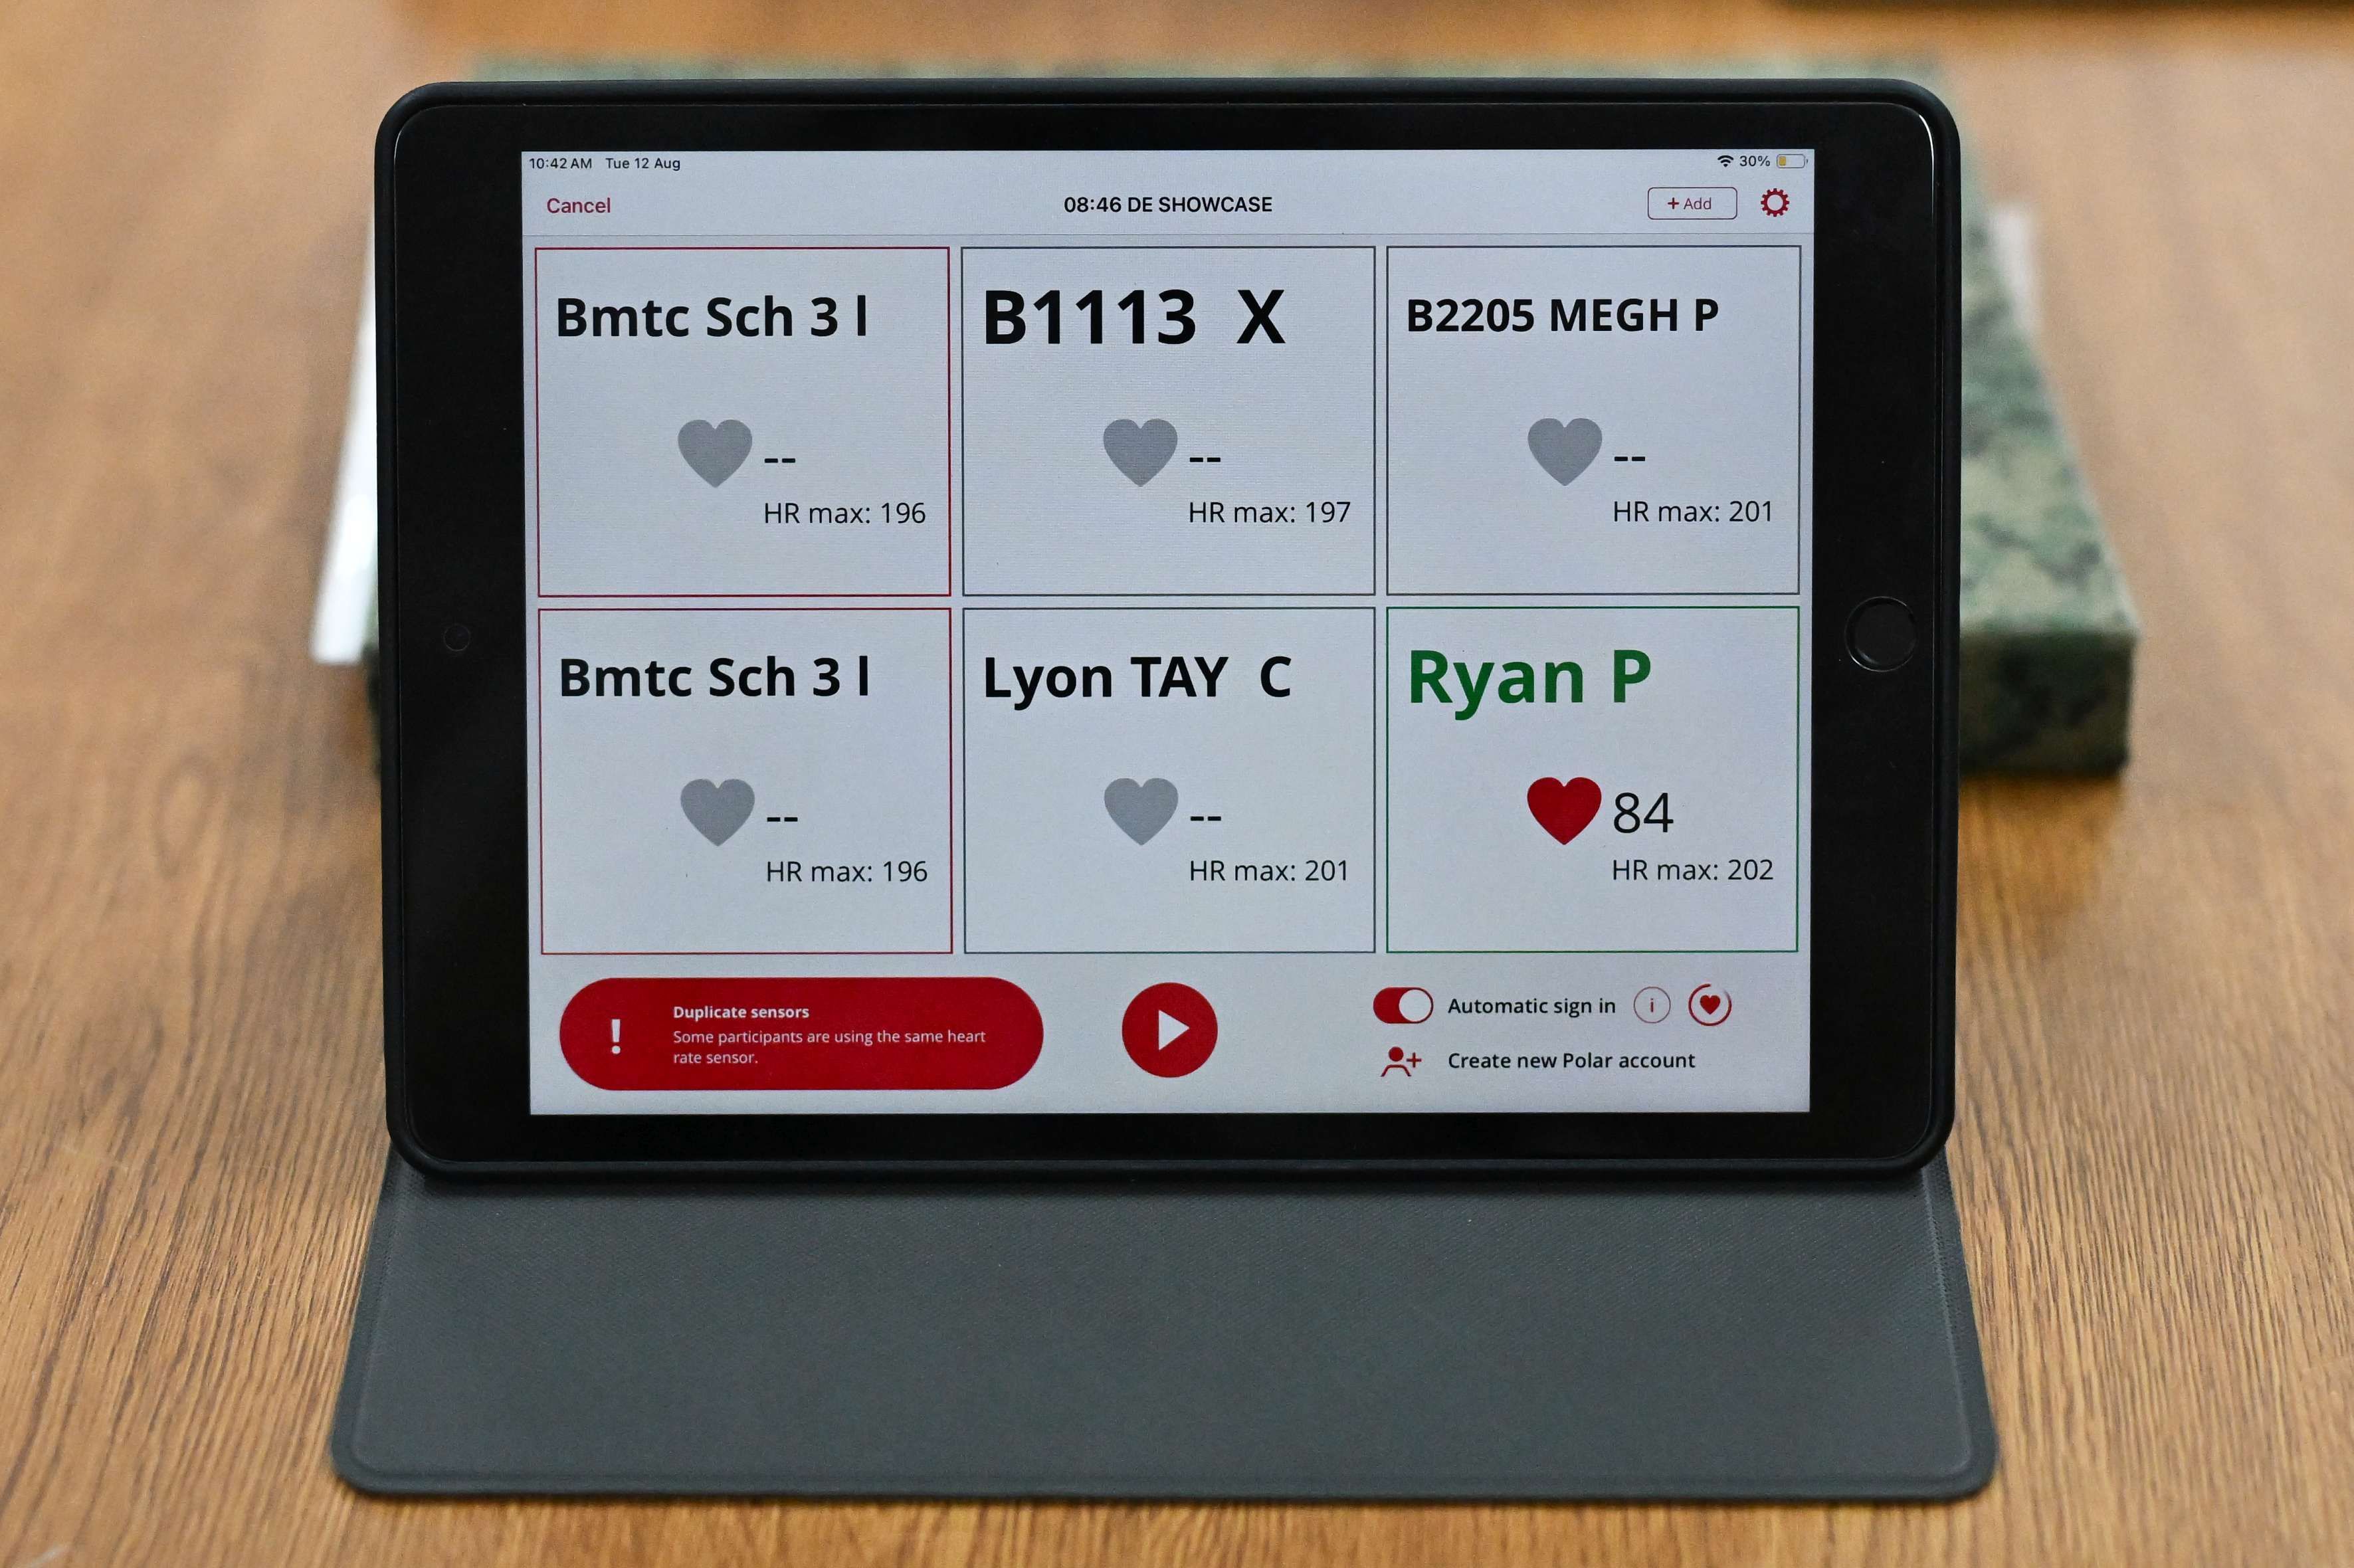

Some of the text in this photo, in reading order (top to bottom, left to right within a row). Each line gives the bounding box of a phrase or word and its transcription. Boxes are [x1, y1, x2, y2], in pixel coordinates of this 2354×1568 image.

[529, 157, 592, 169] 10:42 AM
[605, 157, 680, 172] Tue 12 Aug
[1739, 155, 1771, 167] 30%
[547, 197, 611, 214] Cancel
[1064, 196, 1272, 213] 08:46 DE SHOWCASE
[1683, 197, 1712, 211] Add
[557, 298, 690, 338] Bmtc
[706, 294, 793, 338] Sch
[811, 296, 838, 337] 3
[985, 289, 1286, 345] B1113 X
[1408, 298, 1719, 333] B2205 MEGH P
[765, 502, 926, 524] HR max: 196
[1189, 501, 1351, 524] HR max: 197
[1614, 500, 1771, 522] HR max: 201
[561, 658, 692, 698] Bmtc
[709, 655, 795, 697] Sch
[813, 657, 840, 697] 3
[985, 656, 1292, 711] Lyon TAY C
[1411, 649, 1651, 721] Ryan P
[1613, 792, 1674, 834] 84
[767, 860, 928, 882] HR max: 196
[1190, 860, 1346, 882] HR max: 201
[1613, 858, 1774, 881] HR max: 202
[673, 1005, 810, 1023] Duplicate sensors
[1447, 997, 1616, 1017] Automatic sign in
[611, 1019, 621, 1054] !
[673, 1029, 986, 1046] Some participants are using the same heart
[673, 1052, 758, 1064] rate sensor.
[1448, 1052, 1696, 1069] Create new Polar account
